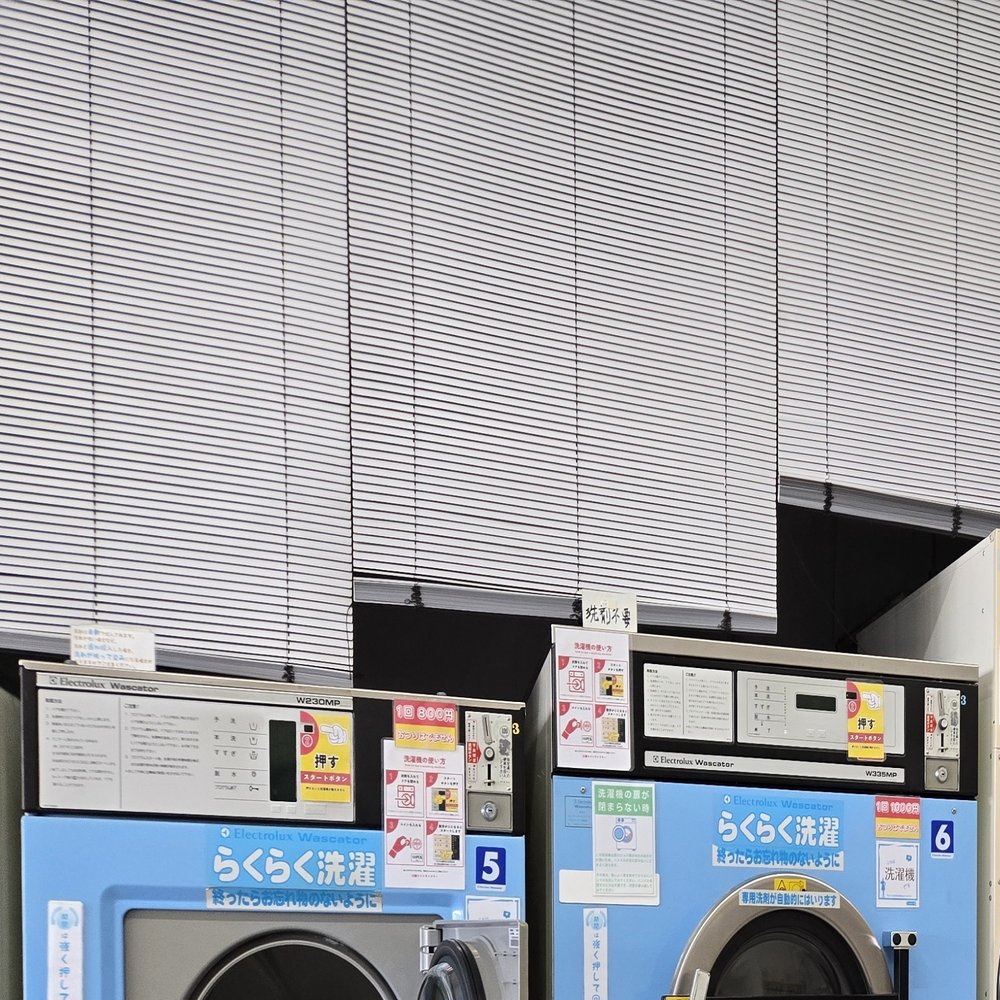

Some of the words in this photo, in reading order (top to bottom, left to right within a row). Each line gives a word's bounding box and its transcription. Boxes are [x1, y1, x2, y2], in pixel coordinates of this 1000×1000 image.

[585, 604, 631, 629] 洗剤不要
[60, 677, 105, 689] Electrolux
[110, 682, 159, 692] Wascator
[296, 697, 341, 706] W230MP
[961, 694, 967, 706] 3
[396, 704, 415, 720] 1回
[417, 705, 455, 722] 800円
[512, 722, 520, 735] 3
[858, 718, 875, 730] 押す
[850, 734, 882, 742] スタートボタン
[315, 753, 339, 769] 押す
[403, 755, 446, 765] 洗濯機の使い方
[660, 756, 693, 766] Electrolux
[695, 759, 734, 768] Wascator
[304, 773, 347, 782] スタートボタン
[866, 770, 897, 778] W335MP
[598, 788, 649, 800] 洗濯機の扉が
[598, 801, 650, 813] 閉まらない時
[733, 795, 778, 808] Electrolux
[781, 799, 833, 811] Wascator
[875, 801, 889, 813] 1回
[890, 801, 920, 815] 1000円
[718, 810, 839, 847] らくらく洗濯
[235, 828, 293, 841] Electrolux
[298, 832, 367, 845] Wascator
[935, 824, 951, 851] 6
[213, 846, 376, 887] らくらく洗濯
[481, 851, 500, 881] 5
[885, 866, 915, 881] 洗濯機
[742, 891, 837, 907] 専用洗剤が自動的にはいります
